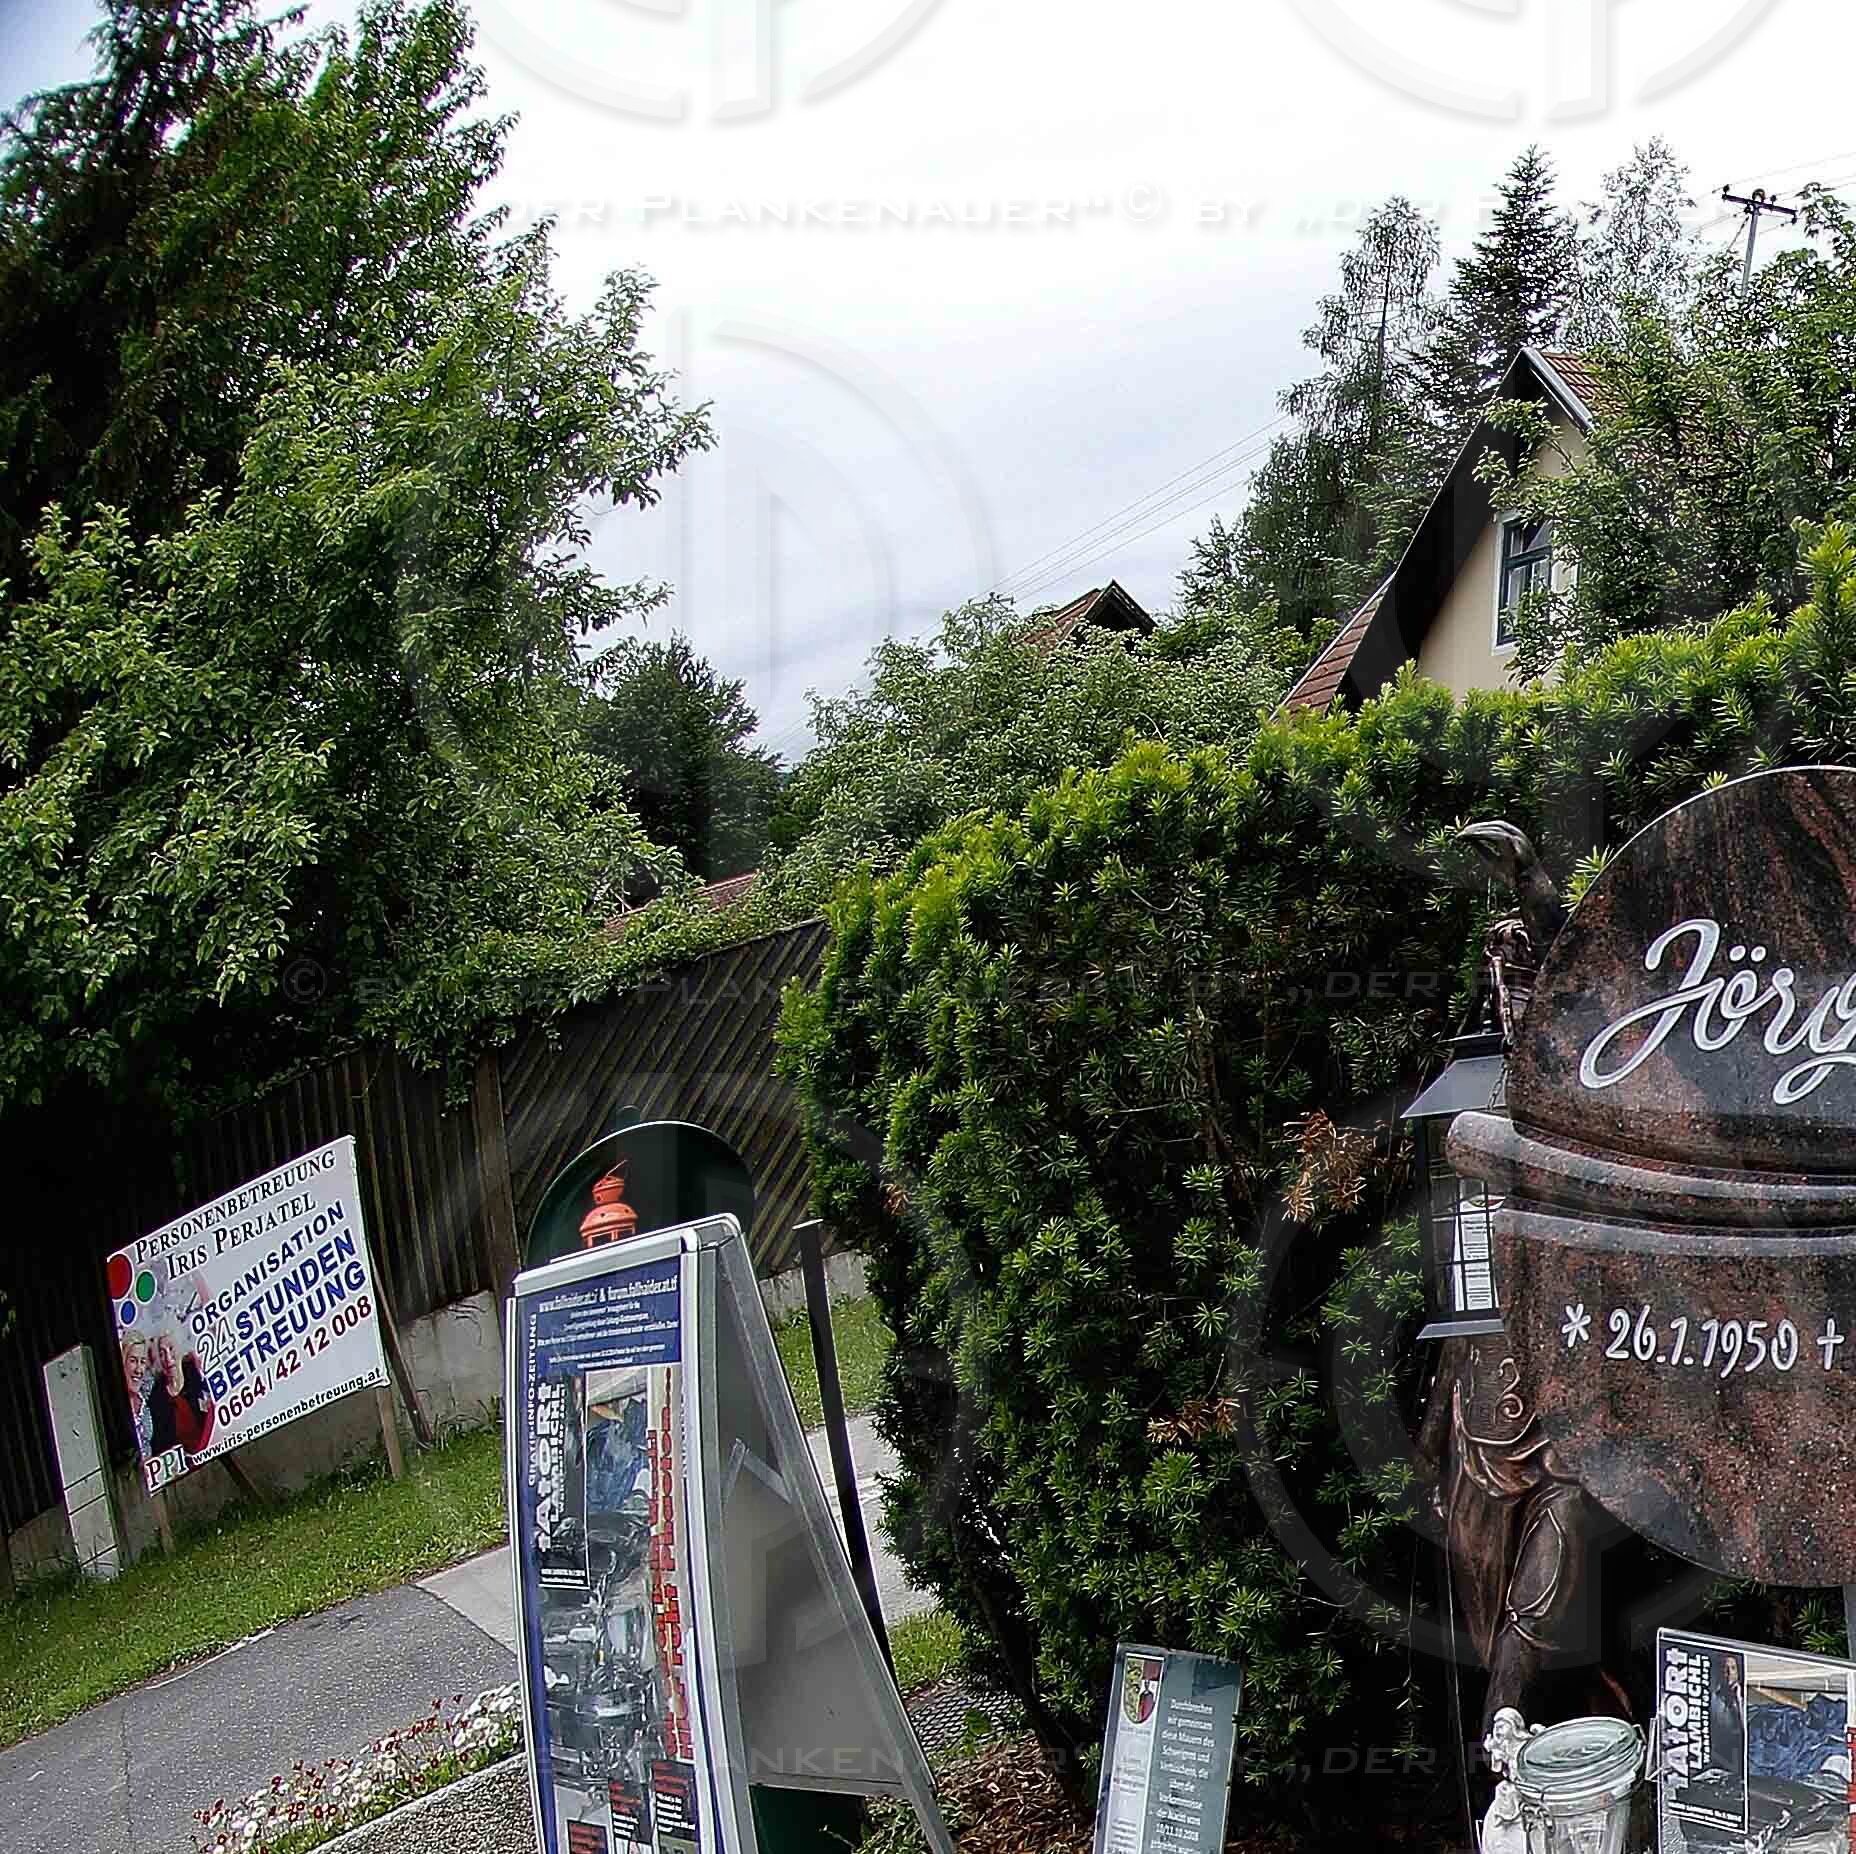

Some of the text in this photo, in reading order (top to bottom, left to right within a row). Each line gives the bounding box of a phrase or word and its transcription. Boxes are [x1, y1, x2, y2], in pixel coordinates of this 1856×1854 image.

[134, 1149, 336, 1264] PERSONENBETREUUNG
[166, 1191, 317, 1281] IRIS PERJATEL
[191, 1201, 345, 1336] ORGANISATION
[197, 1228, 357, 1373] 24 STUNDEN
[207, 1261, 367, 1402] BETREUUNG
[303, 1328, 330, 1359] 12
[331, 1295, 373, 1338] 008
[145, 1445, 188, 1491] PPI
[192, 1367, 383, 1467] www.iris-personenbetreuung.at
[1686, 1653, 1704, 1775] LAMBICHL
[1701, 1714, 1713, 1766] Wahrheit
